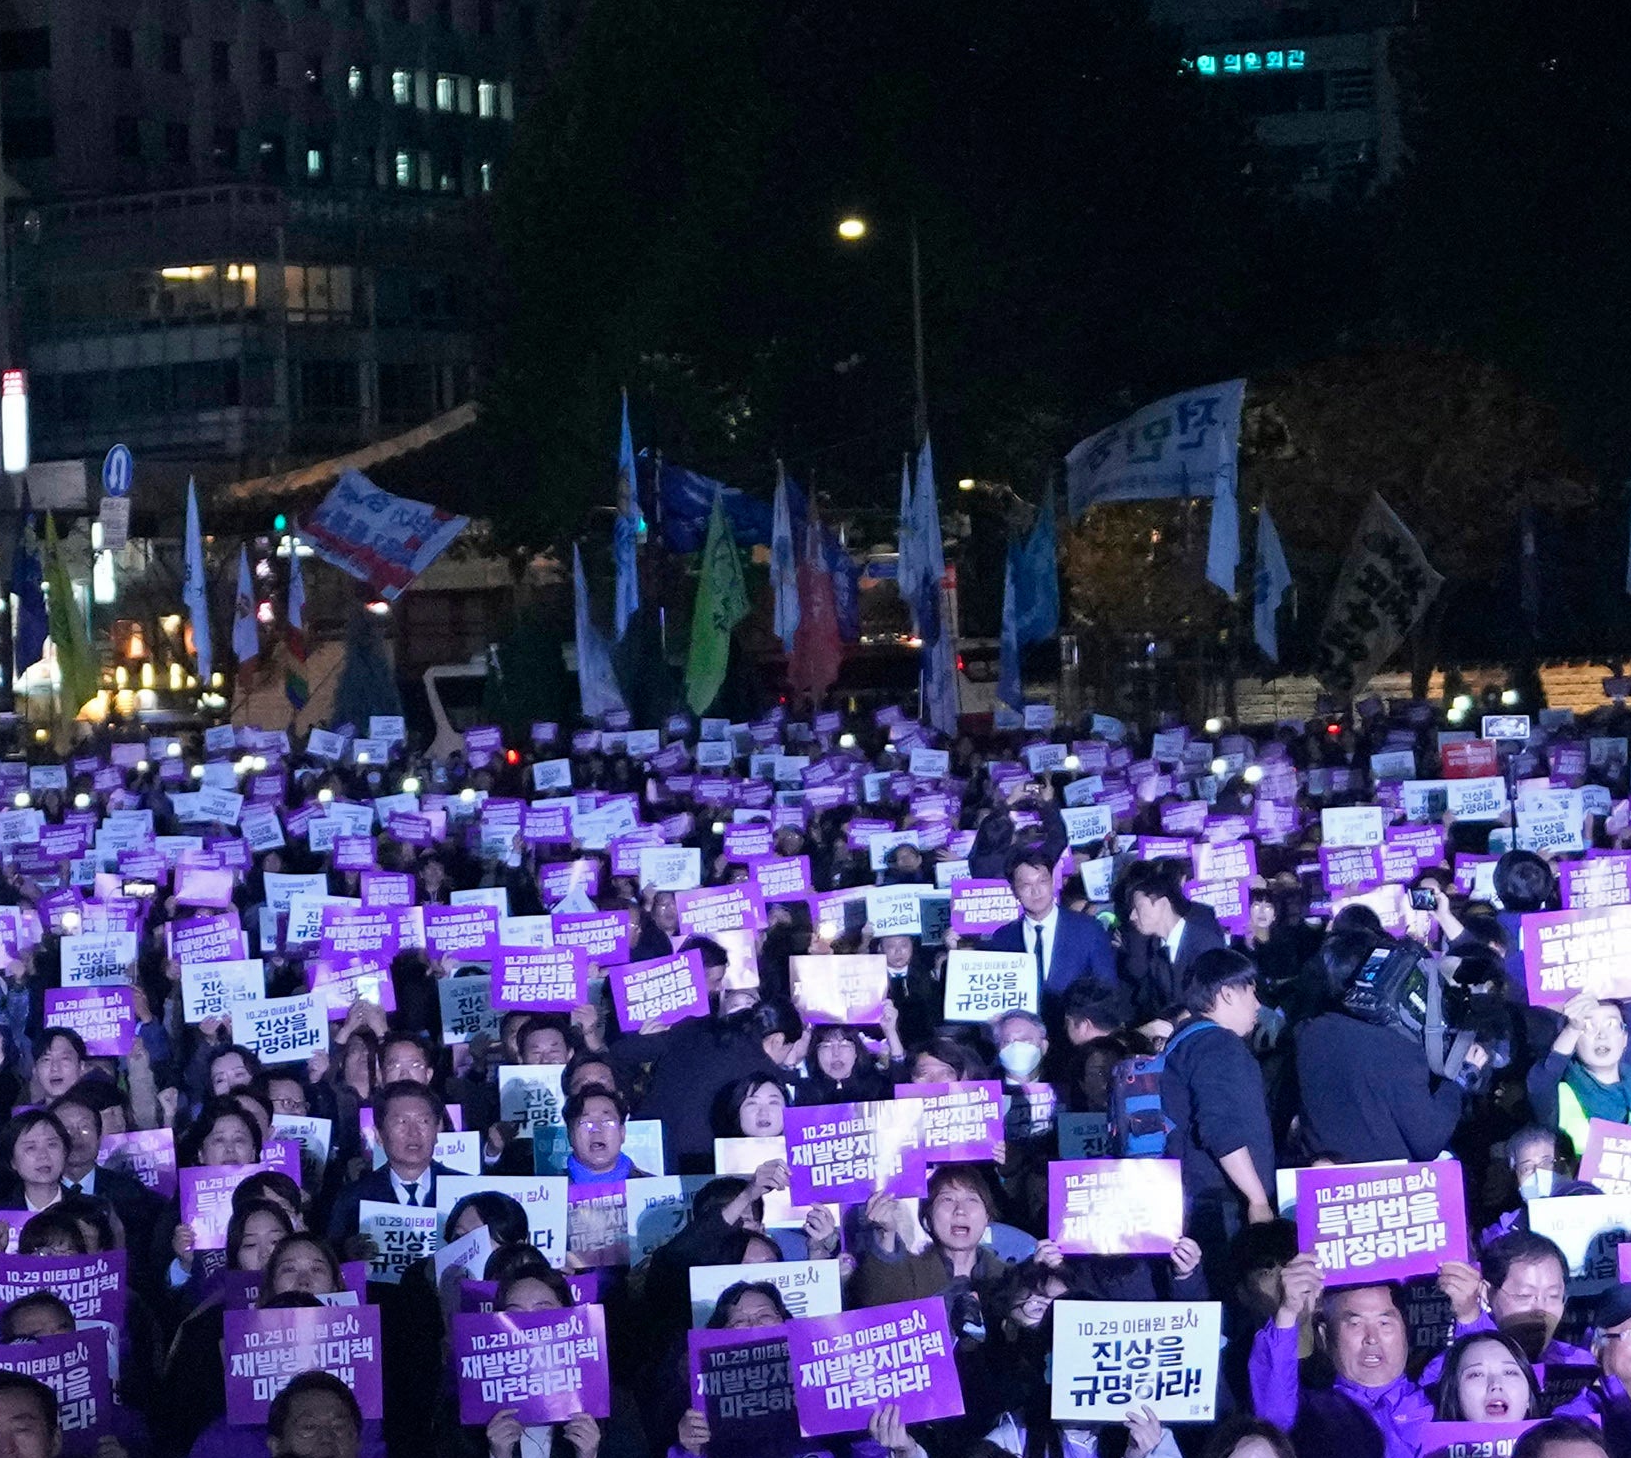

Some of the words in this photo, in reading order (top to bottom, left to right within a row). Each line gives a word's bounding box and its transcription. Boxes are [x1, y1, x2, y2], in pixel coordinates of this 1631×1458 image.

[78, 949, 116, 965] 진상을
[506, 963, 575, 984] 특별법을
[627, 972, 692, 999] 특별법을
[968, 973, 1018, 991] 진상을
[501, 983, 577, 1003] 제정하라!
[628, 990, 699, 1021] 제정하라!
[956, 991, 1027, 1011] 규명하라!
[255, 1017, 306, 1036] 진상을
[802, 1122, 837, 1138] 10.29
[1315, 1186, 1353, 1203] 10.29
[1357, 1181, 1401, 1200] 이태원
[1405, 1168, 1437, 1197] 참사
[1316, 1198, 1440, 1233] 특별법을
[1078, 1319, 1118, 1334] 10.29
[1123, 1316, 1164, 1333] 이태원
[811, 1334, 854, 1354] 10.29
[858, 1324, 896, 1345] 이태원
[799, 1336, 943, 1389] 재발방지대책
[1092, 1339, 1185, 1371] 진상을
[826, 1371, 931, 1408] 마련하라!
[1070, 1370, 1201, 1406] 규명하라!
